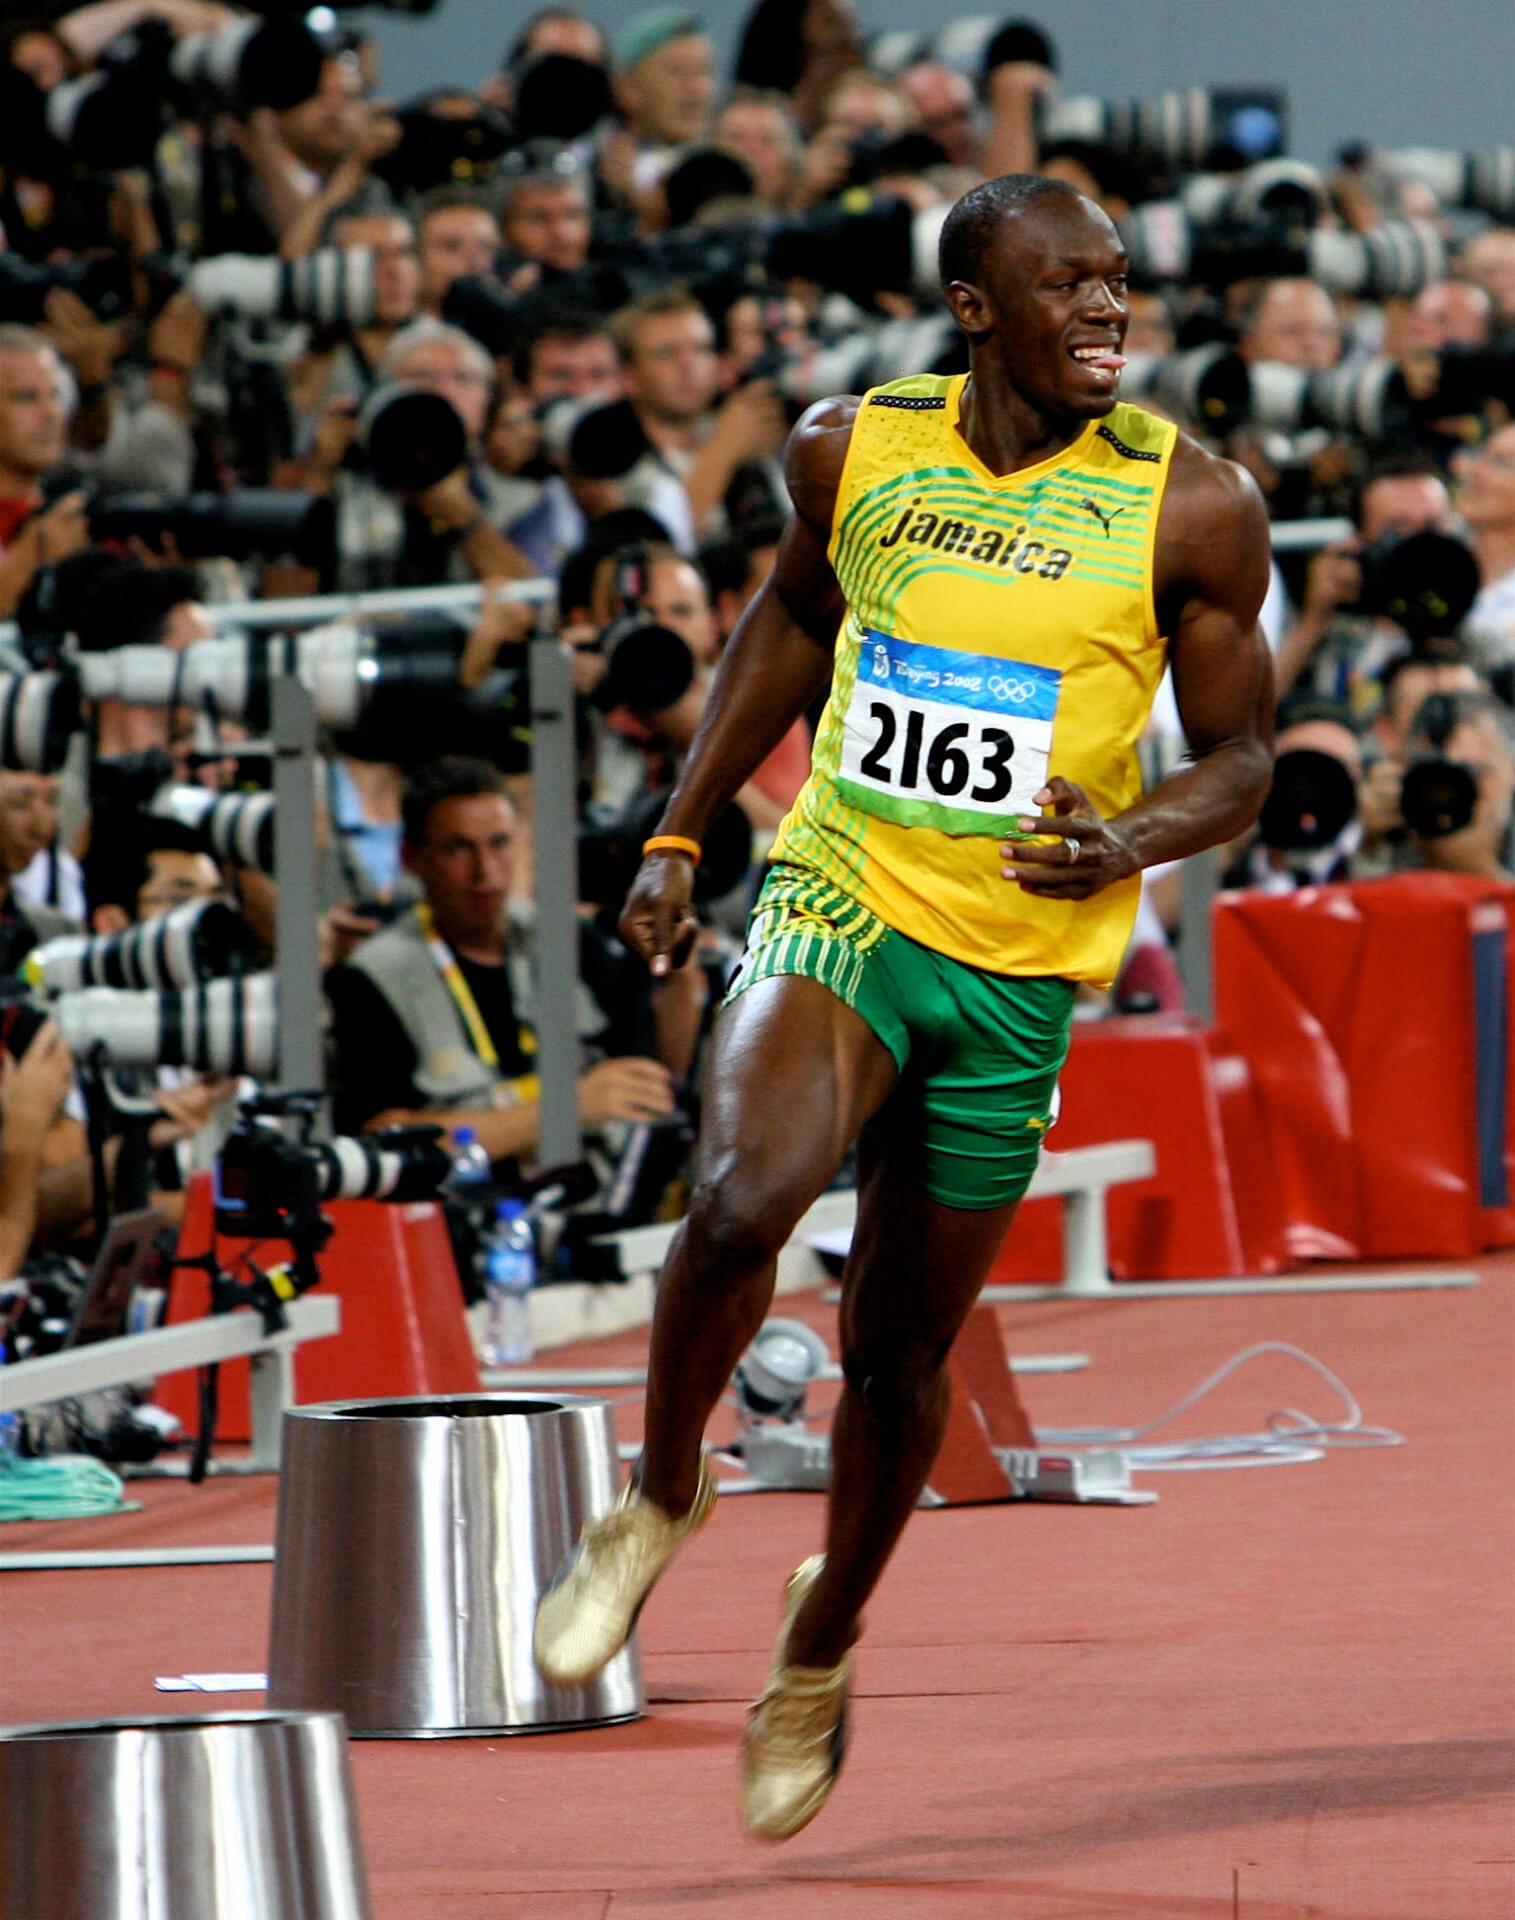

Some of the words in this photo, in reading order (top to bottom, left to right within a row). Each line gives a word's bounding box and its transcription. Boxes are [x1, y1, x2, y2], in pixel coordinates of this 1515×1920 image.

[879, 497, 1073, 581] jamaica
[893, 659, 941, 688] Beijing
[941, 672, 983, 693] 2008
[860, 701, 1015, 803] 2163
